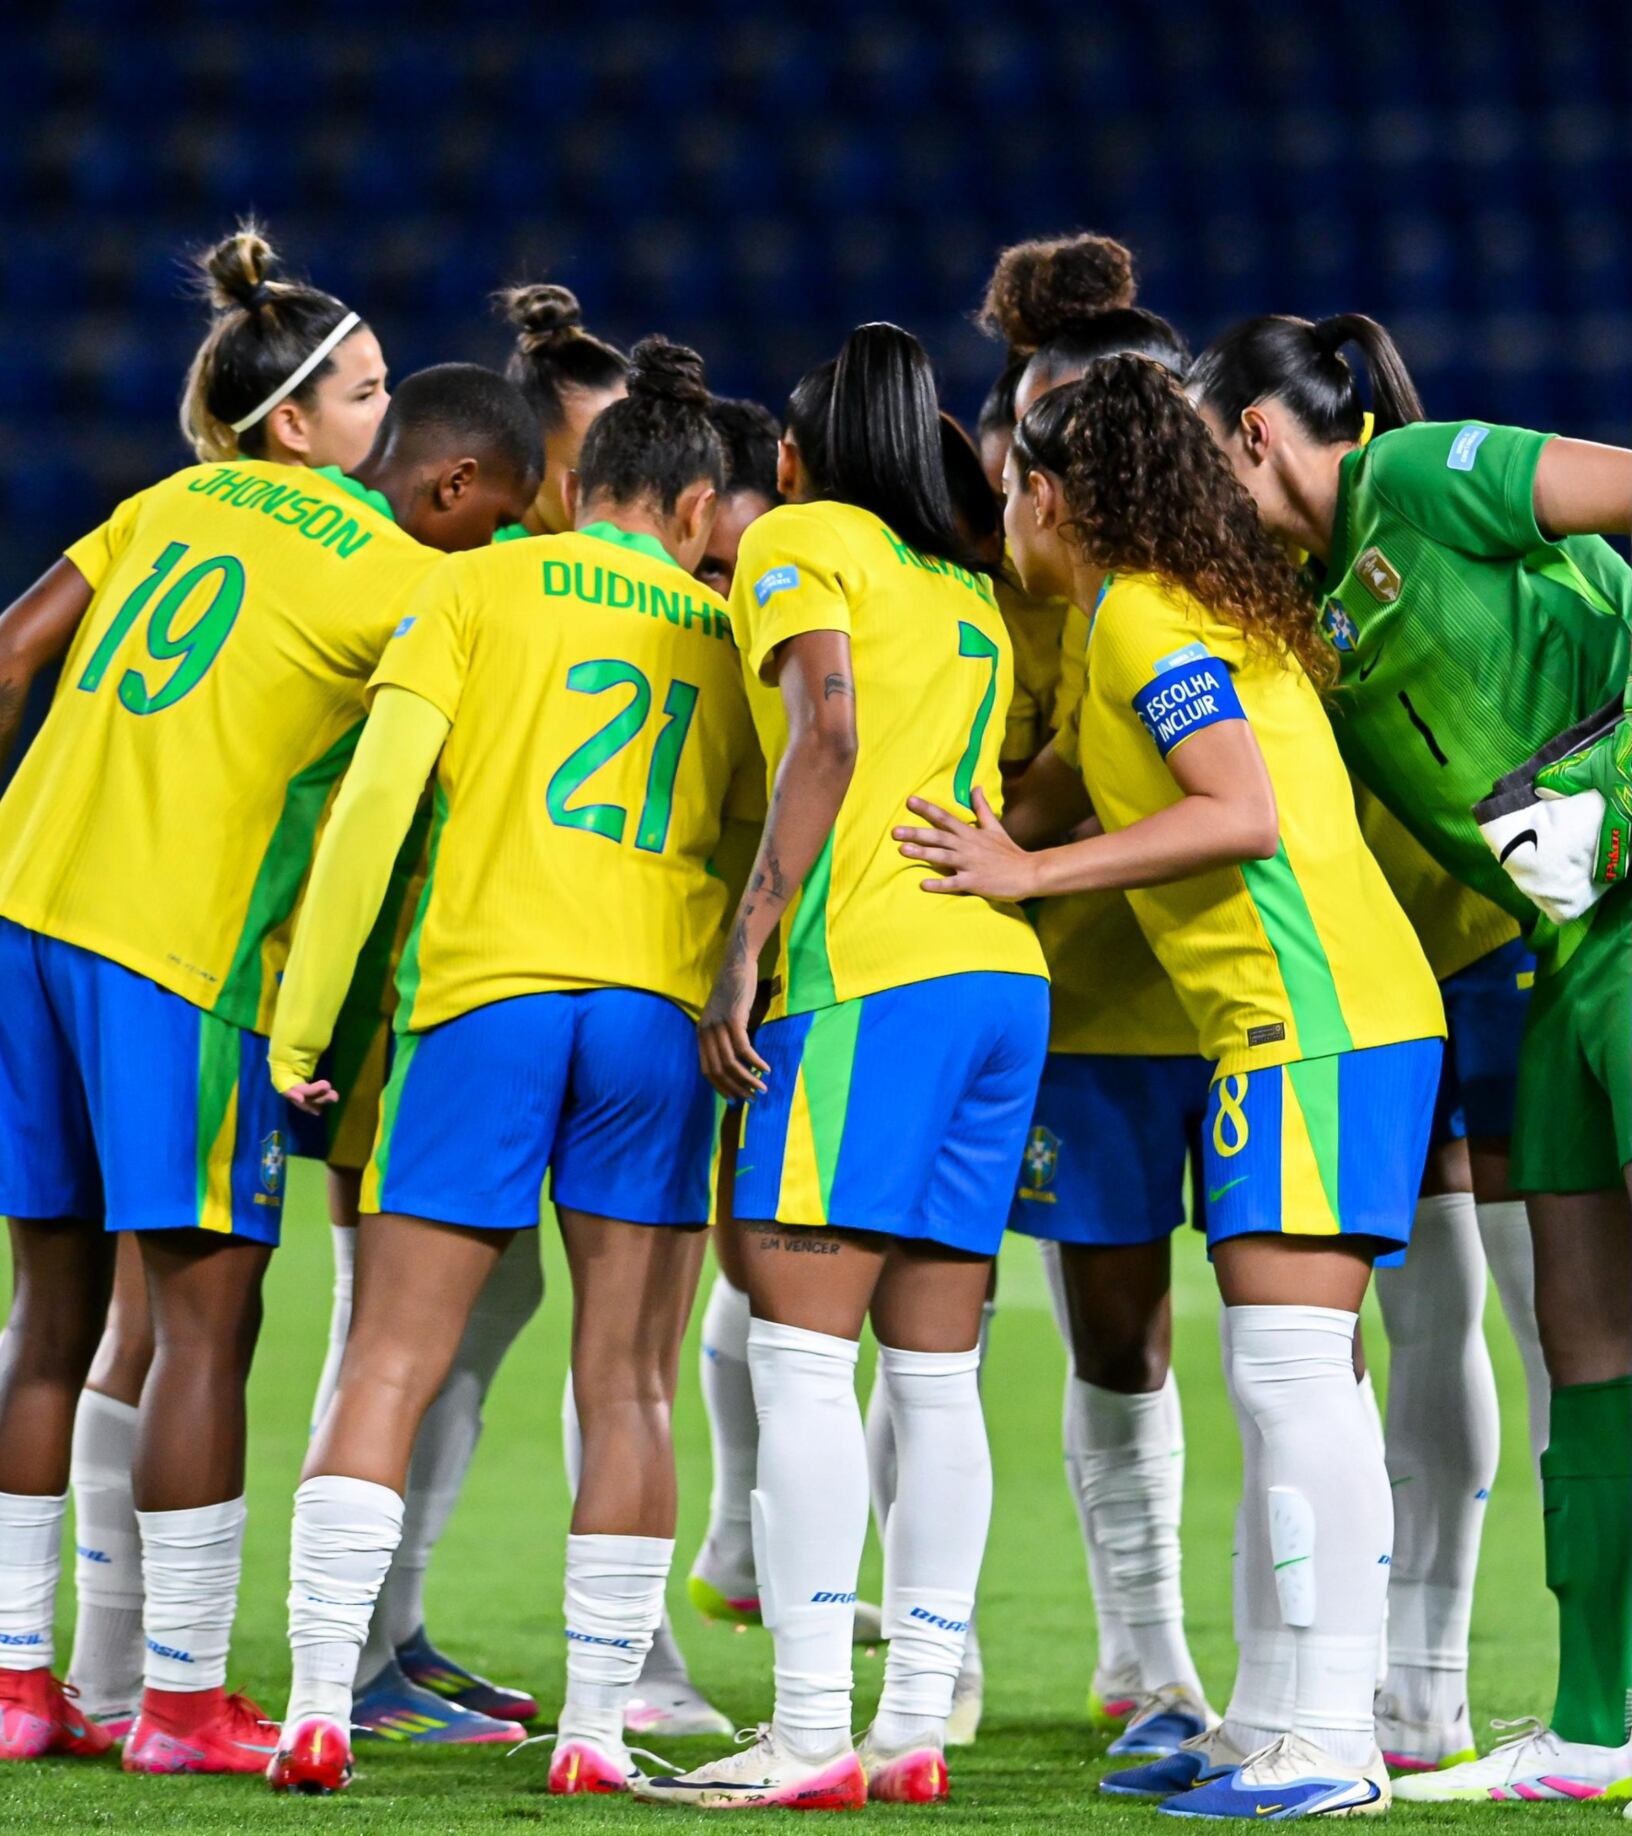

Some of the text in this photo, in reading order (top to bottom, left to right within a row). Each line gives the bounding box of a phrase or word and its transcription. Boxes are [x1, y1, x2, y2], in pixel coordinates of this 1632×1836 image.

[187, 468, 373, 560] JHONSON
[76, 541, 246, 716] 19
[953, 620, 998, 809] 7
[1146, 671, 1220, 722] ESCOLHA
[1157, 694, 1220, 743] INCLUIR
[1398, 690, 1449, 767] 1
[546, 658, 700, 854] 21
[1213, 1072, 1249, 1157] 8
[760, 1238, 841, 1255] EM VENCER
